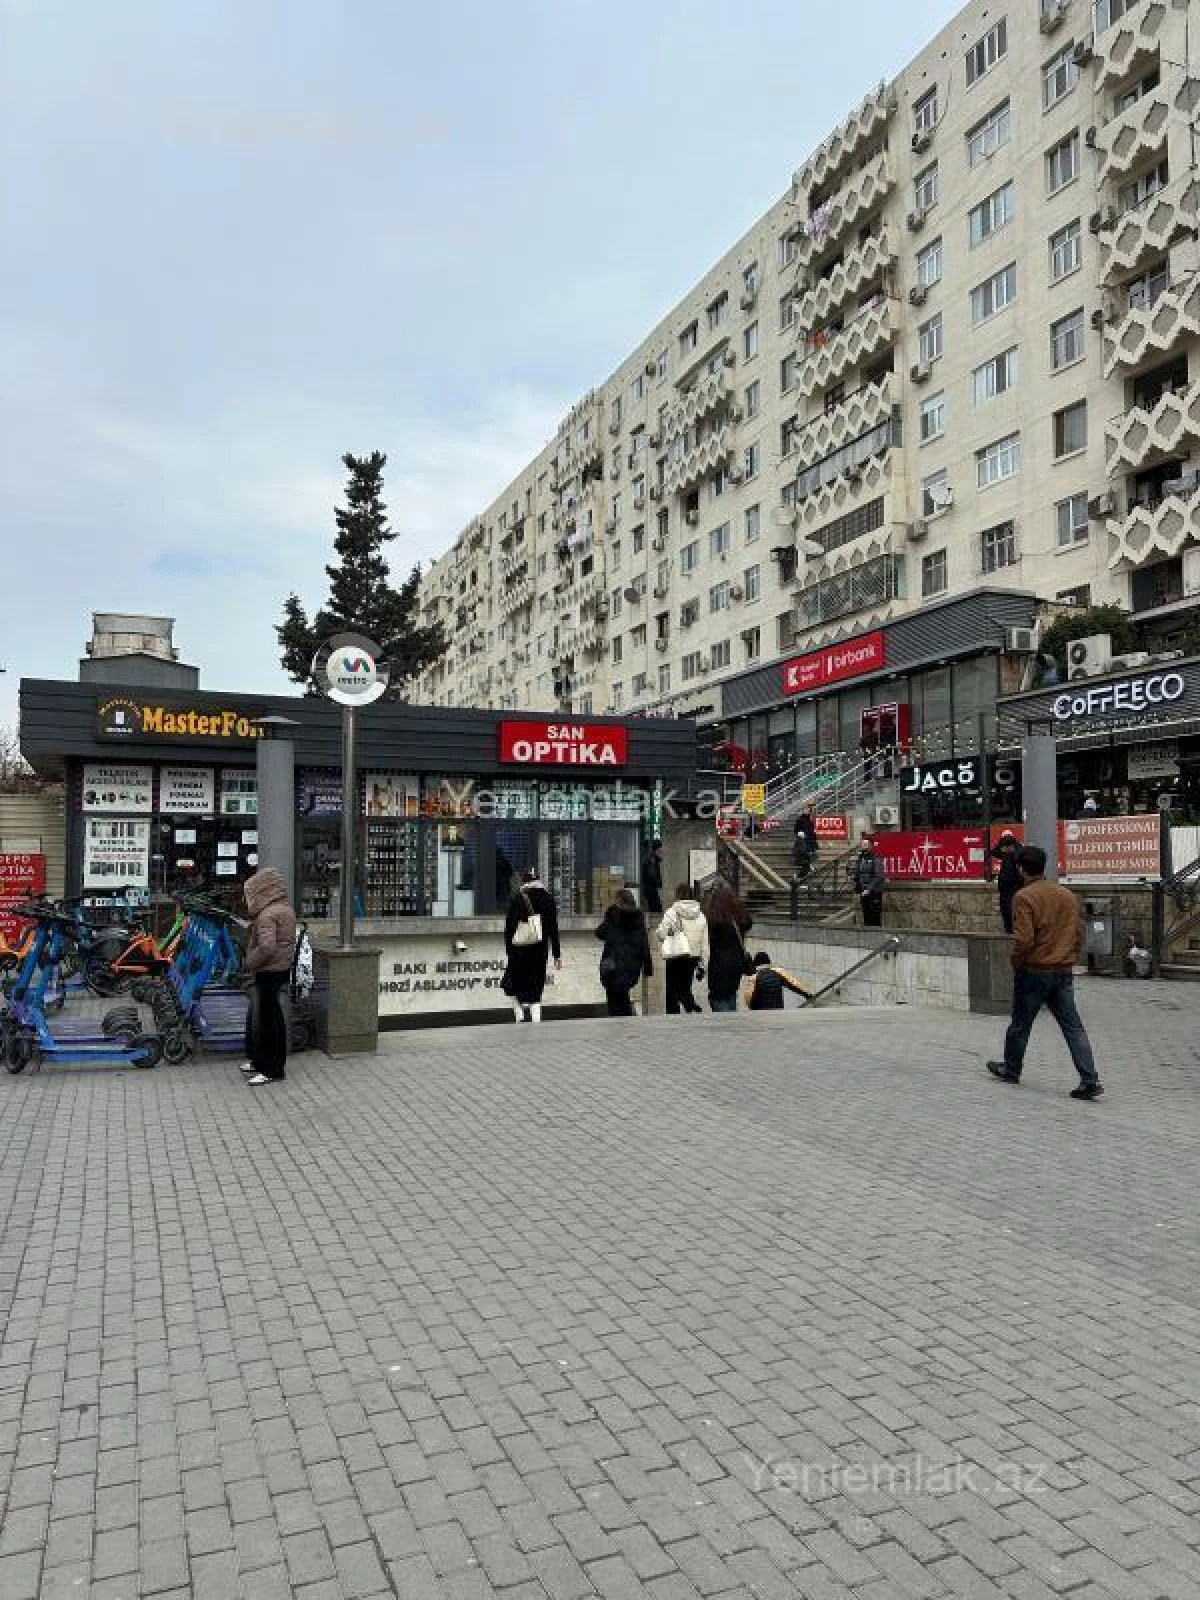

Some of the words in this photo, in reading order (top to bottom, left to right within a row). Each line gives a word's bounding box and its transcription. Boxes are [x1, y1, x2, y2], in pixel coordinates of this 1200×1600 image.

[547, 725, 585, 741] SAN
[815, 817, 843, 829] FOTO
[393, 963, 427, 975] BAKI
